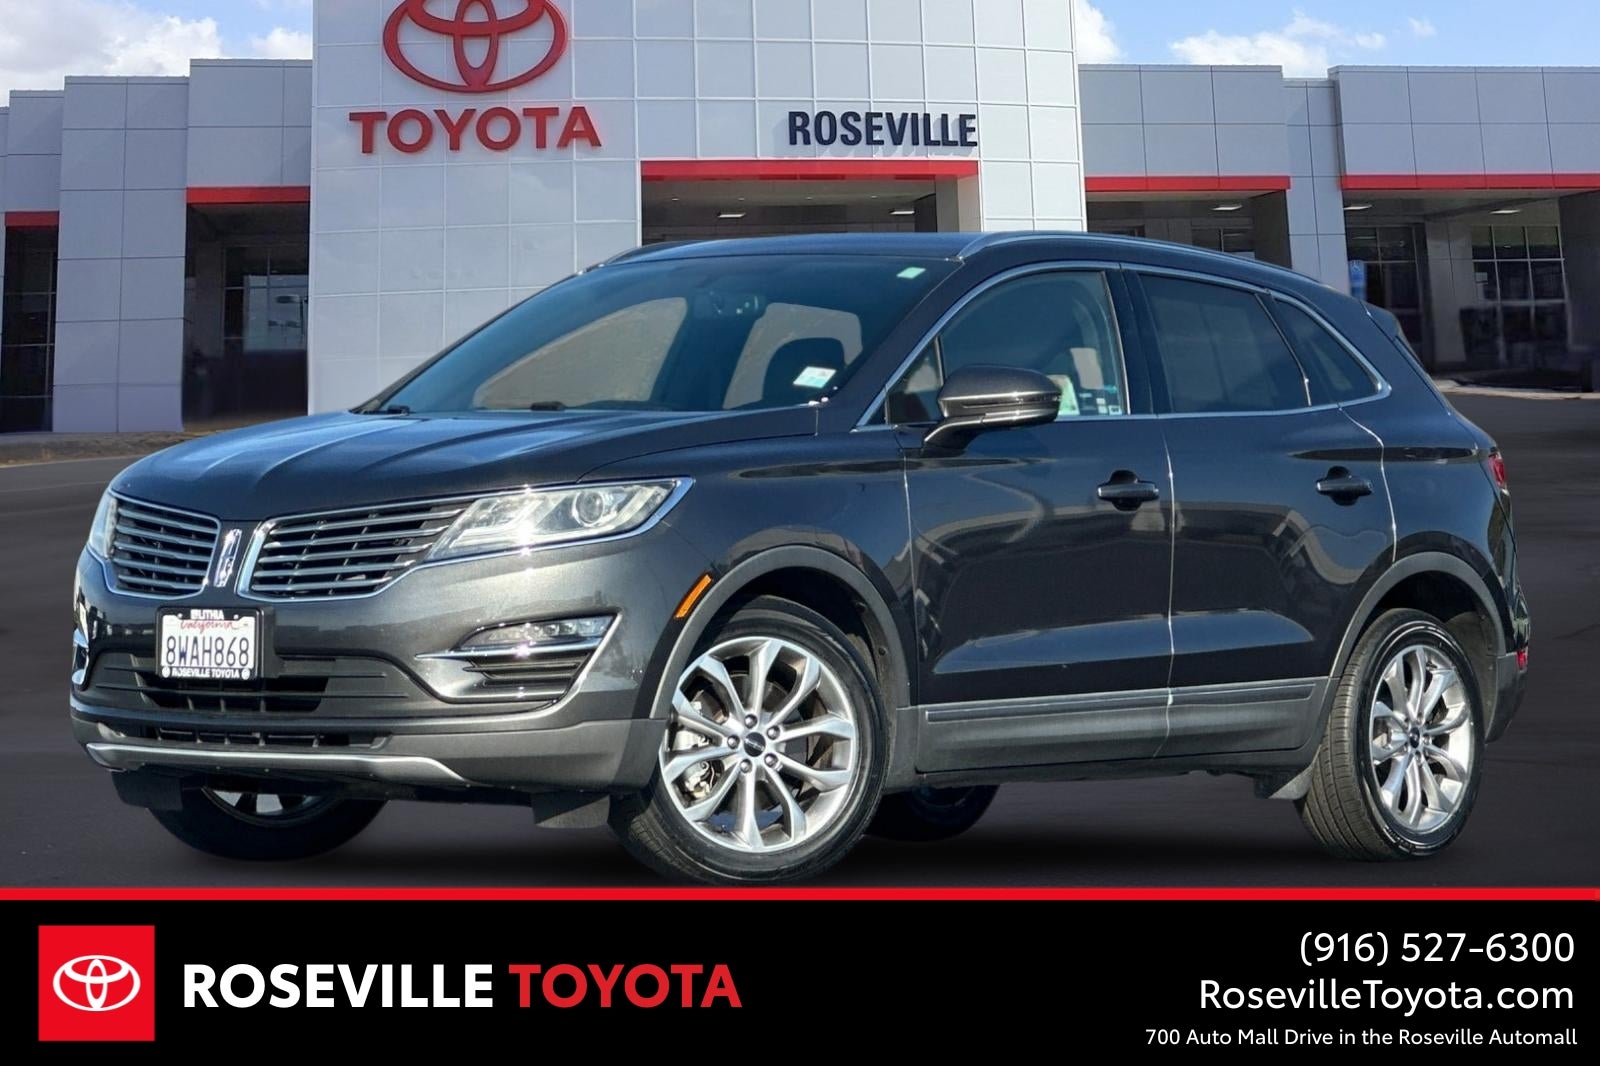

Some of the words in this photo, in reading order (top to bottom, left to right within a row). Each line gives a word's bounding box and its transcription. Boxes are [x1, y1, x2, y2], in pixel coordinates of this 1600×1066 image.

[349, 106, 601, 154] TOYOTA
[788, 111, 978, 147] ROSEVILLE
[166, 635, 249, 667] 8WAH868
[171, 667, 210, 677] ROSEVILLE
[211, 668, 240, 679] TOYOTA
